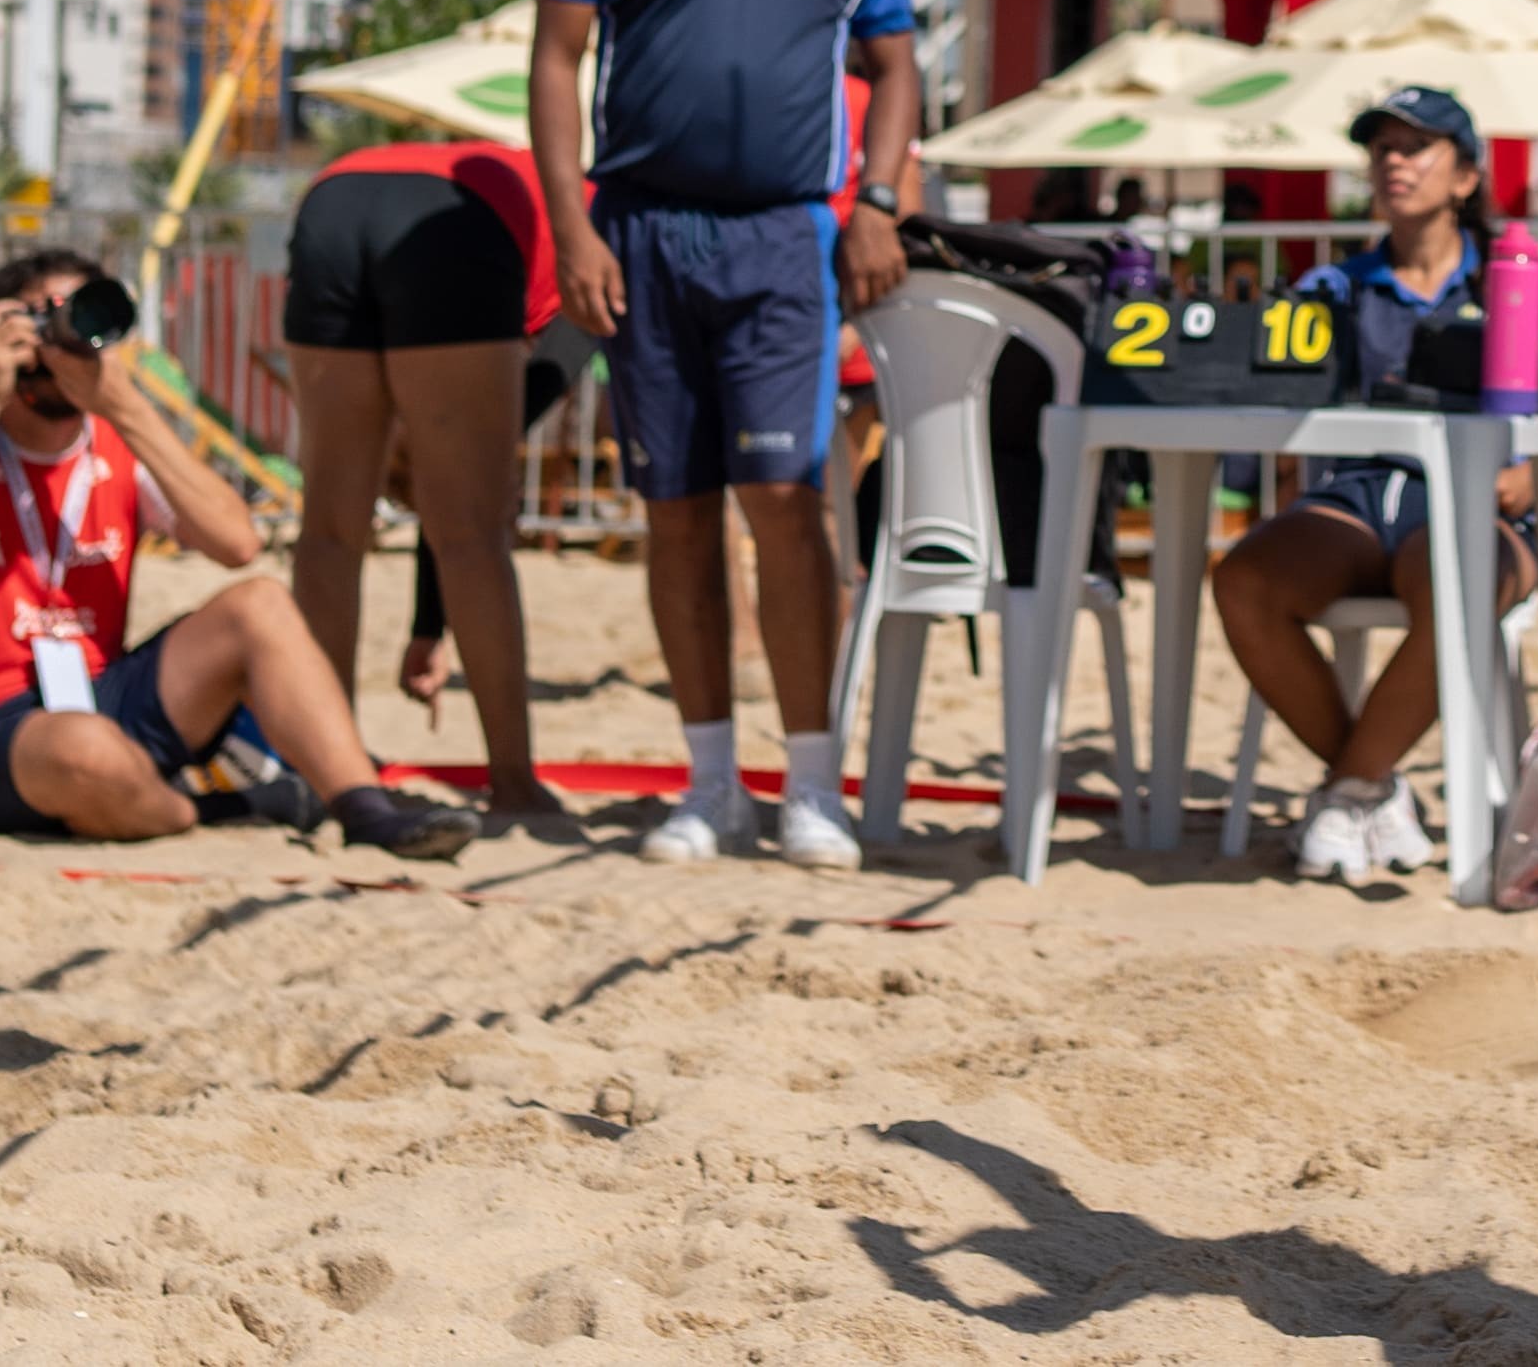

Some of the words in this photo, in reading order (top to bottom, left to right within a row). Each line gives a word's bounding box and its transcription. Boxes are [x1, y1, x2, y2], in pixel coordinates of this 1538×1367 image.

[1107, 301, 1170, 366] 2
[1182, 302, 1216, 339] 0
[1263, 300, 1333, 364] 10
